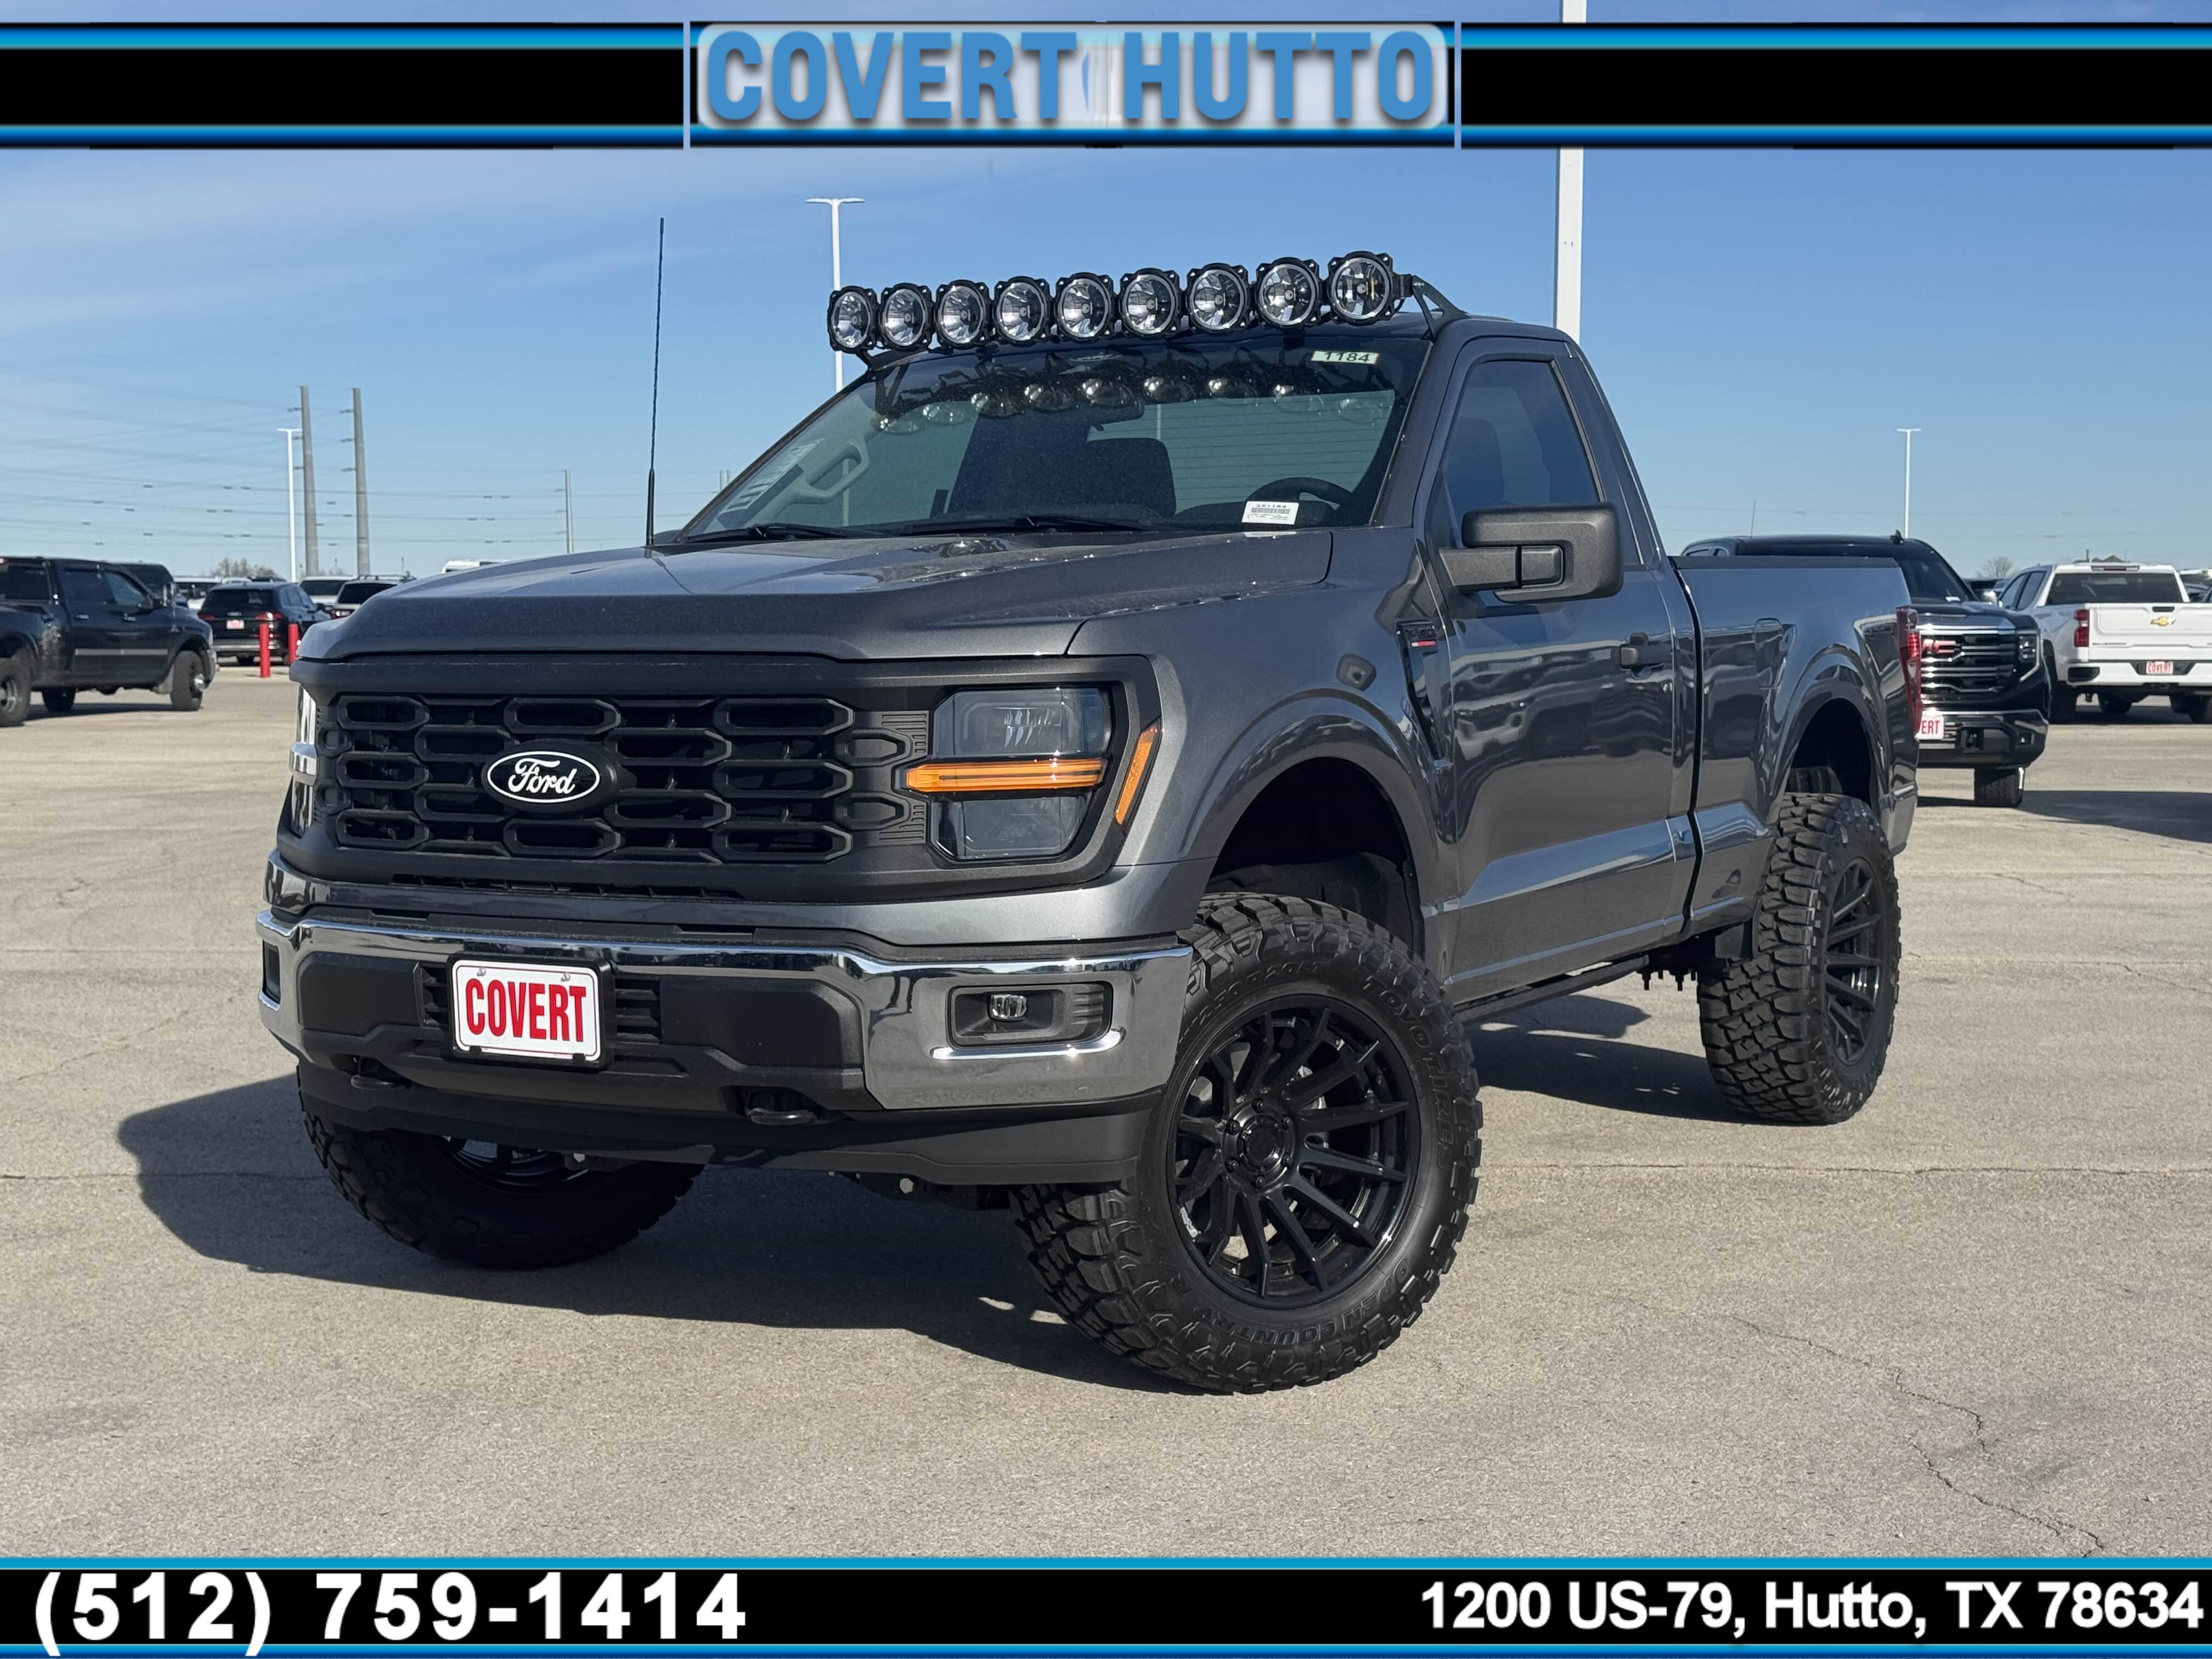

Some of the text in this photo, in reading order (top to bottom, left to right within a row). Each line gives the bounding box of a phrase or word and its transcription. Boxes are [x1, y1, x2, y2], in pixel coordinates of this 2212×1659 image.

[1324, 352, 1370, 362] 1184
[2148, 662, 2171, 673] COVERT
[508, 758, 578, 794] Ford
[466, 978, 587, 1042] COVERT
[1363, 975, 1454, 1172] TOYO TIRES
[1342, 1258, 1413, 1330] OPEN
[1194, 1307, 1337, 1346] COUNTRY
